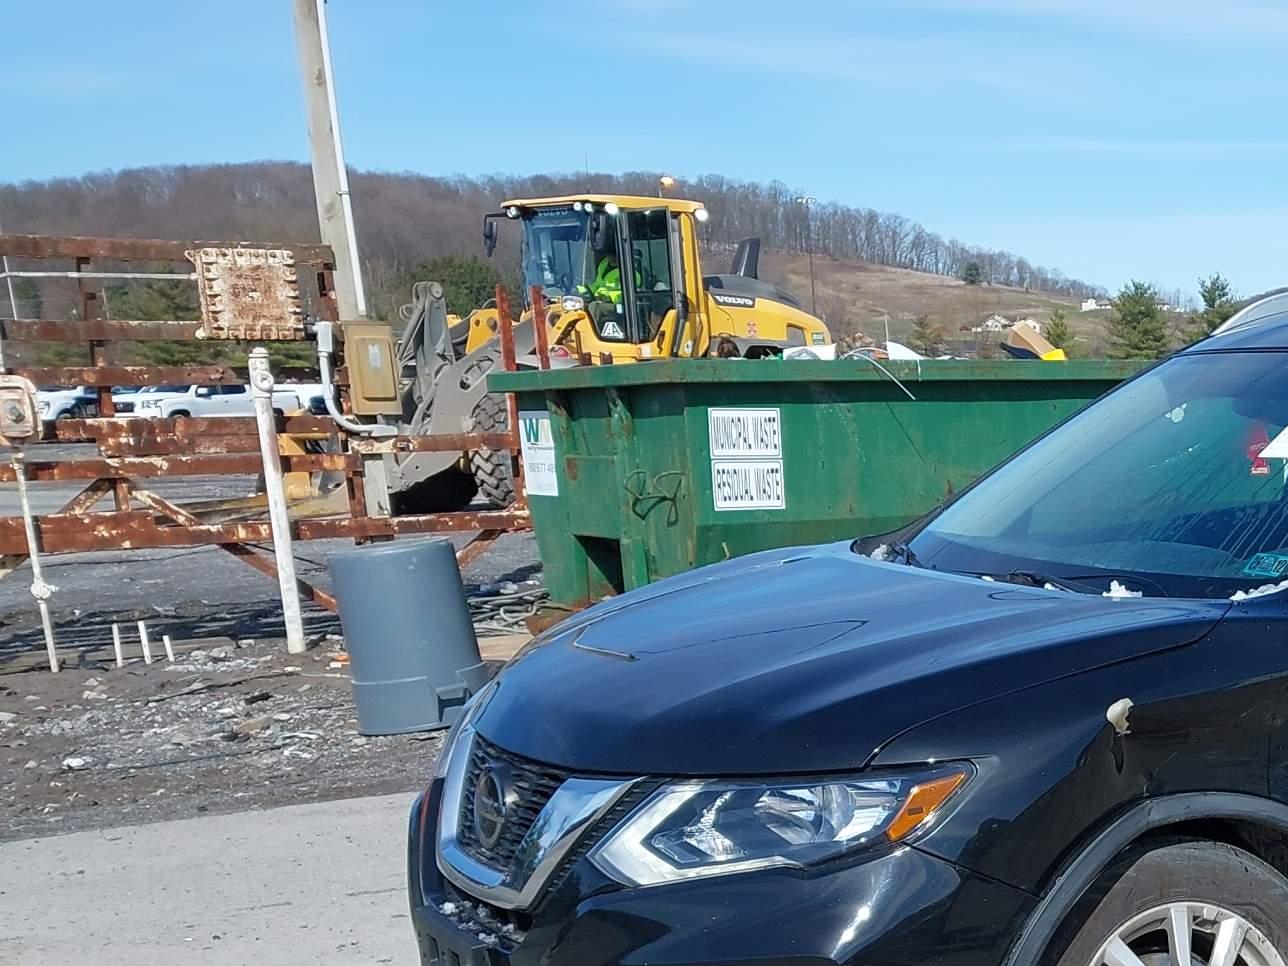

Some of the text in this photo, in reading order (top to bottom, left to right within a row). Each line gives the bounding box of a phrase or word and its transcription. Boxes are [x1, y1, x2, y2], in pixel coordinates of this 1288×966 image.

[714, 296, 753, 305] VOLVO
[713, 416, 778, 450] MUNICIPAL WASTE
[717, 467, 780, 501] RESIDUAL WASTE
